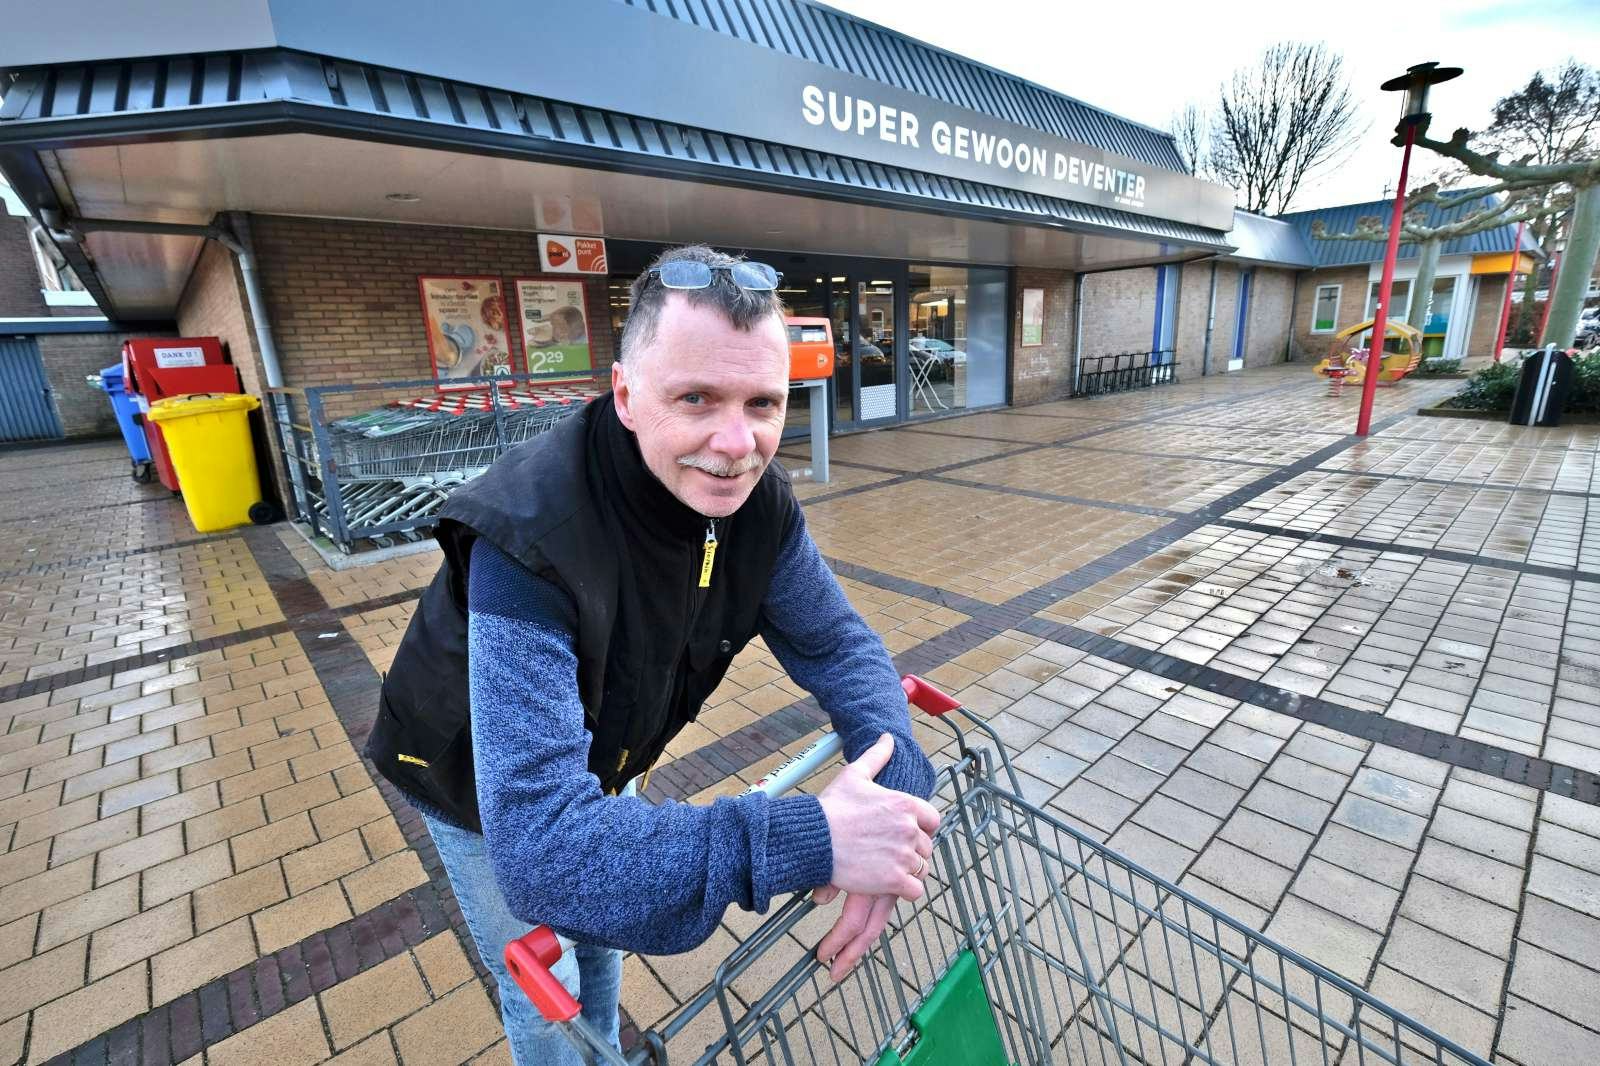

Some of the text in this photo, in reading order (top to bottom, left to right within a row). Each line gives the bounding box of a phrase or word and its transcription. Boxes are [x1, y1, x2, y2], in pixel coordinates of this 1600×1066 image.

[802, 85, 1146, 200] SUPER GEWOON DEVENTER
[161, 351, 185, 359] DANK
